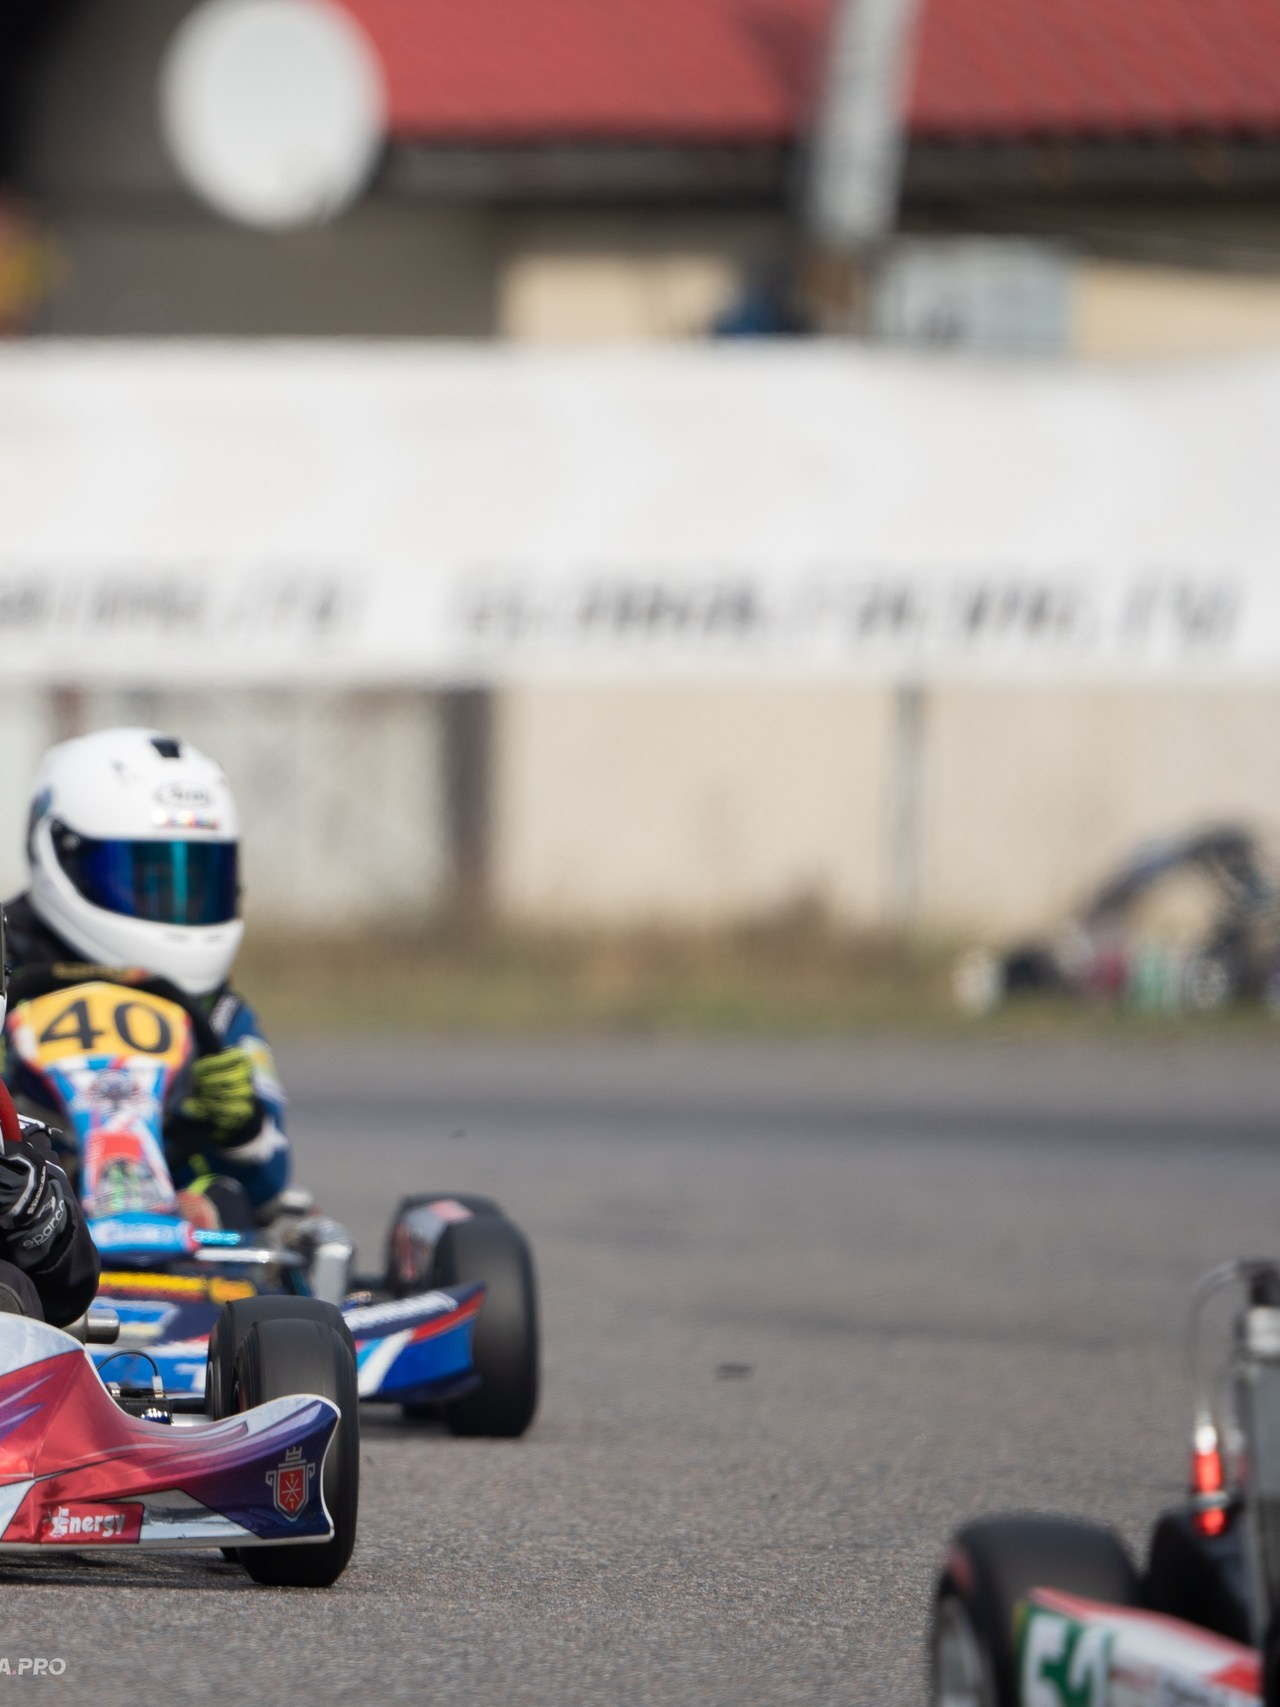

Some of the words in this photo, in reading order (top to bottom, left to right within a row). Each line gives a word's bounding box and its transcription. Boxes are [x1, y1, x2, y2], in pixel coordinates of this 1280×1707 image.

[39, 999, 172, 1053] 40
[23, 1200, 65, 1249] sparco
[49, 1506, 125, 1537] Energy
